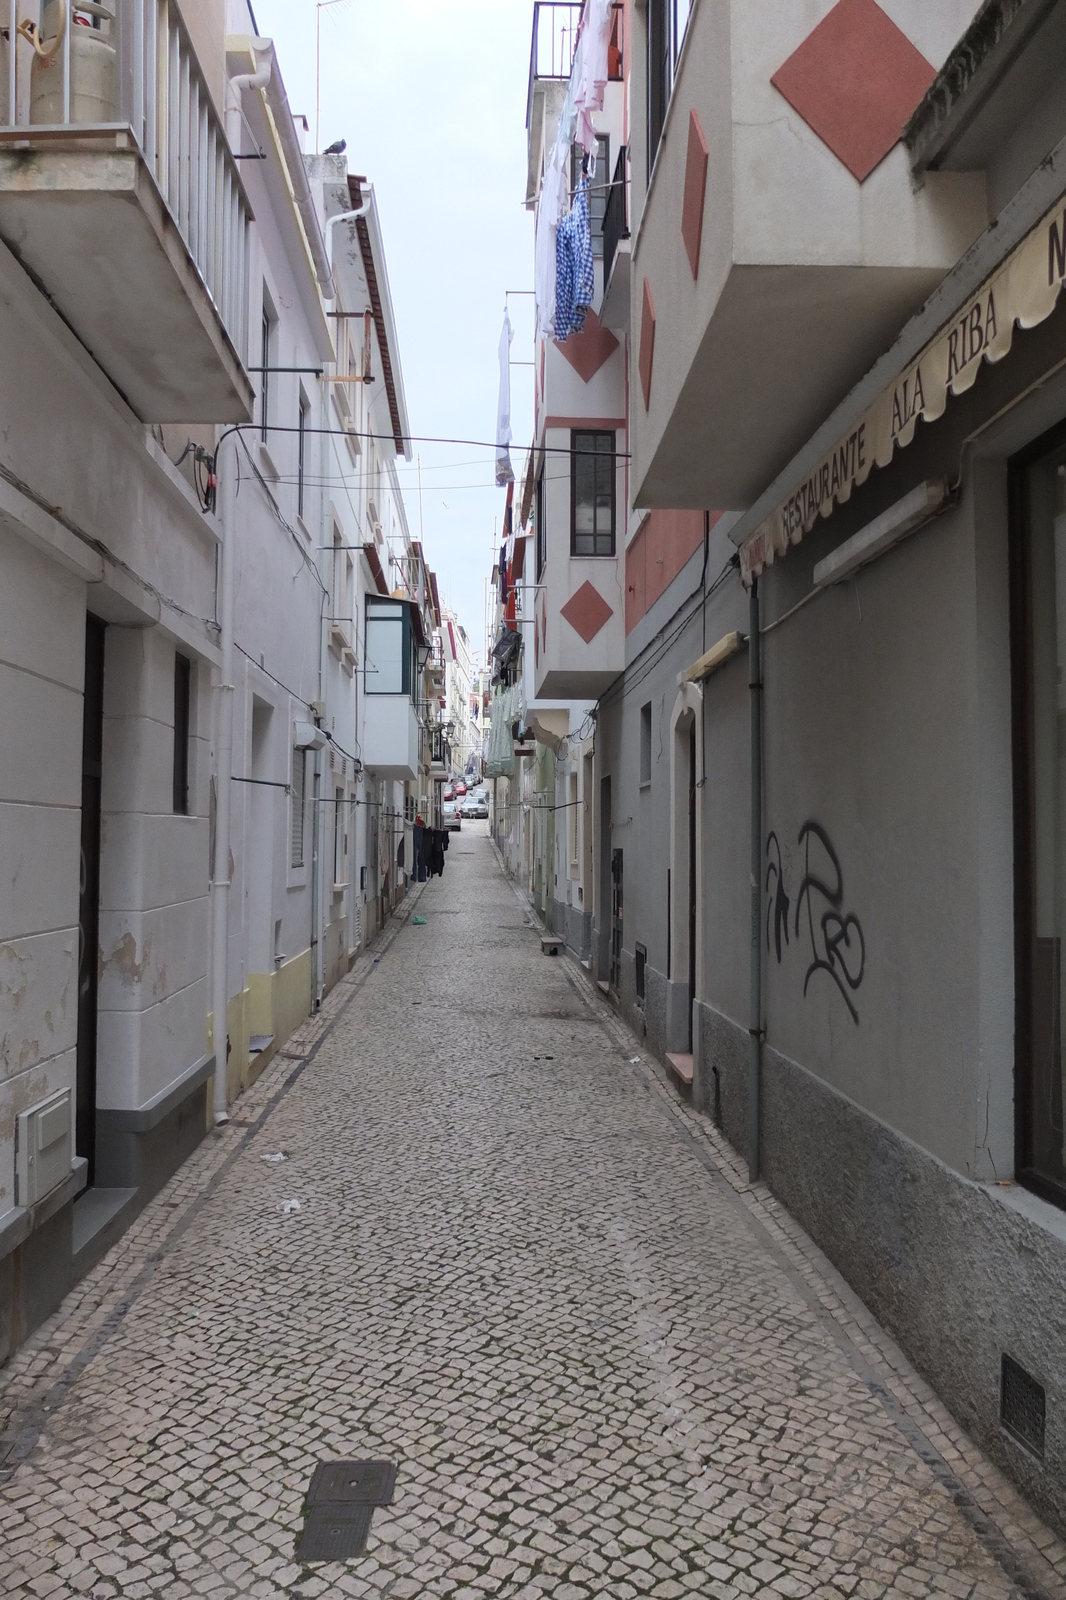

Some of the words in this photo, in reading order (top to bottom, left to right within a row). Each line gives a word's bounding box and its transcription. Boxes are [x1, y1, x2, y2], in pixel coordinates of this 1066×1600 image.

[782, 422, 866, 538] RESTAURANTE
[891, 365, 926, 438] ALA
[945, 287, 998, 385] RIBA
